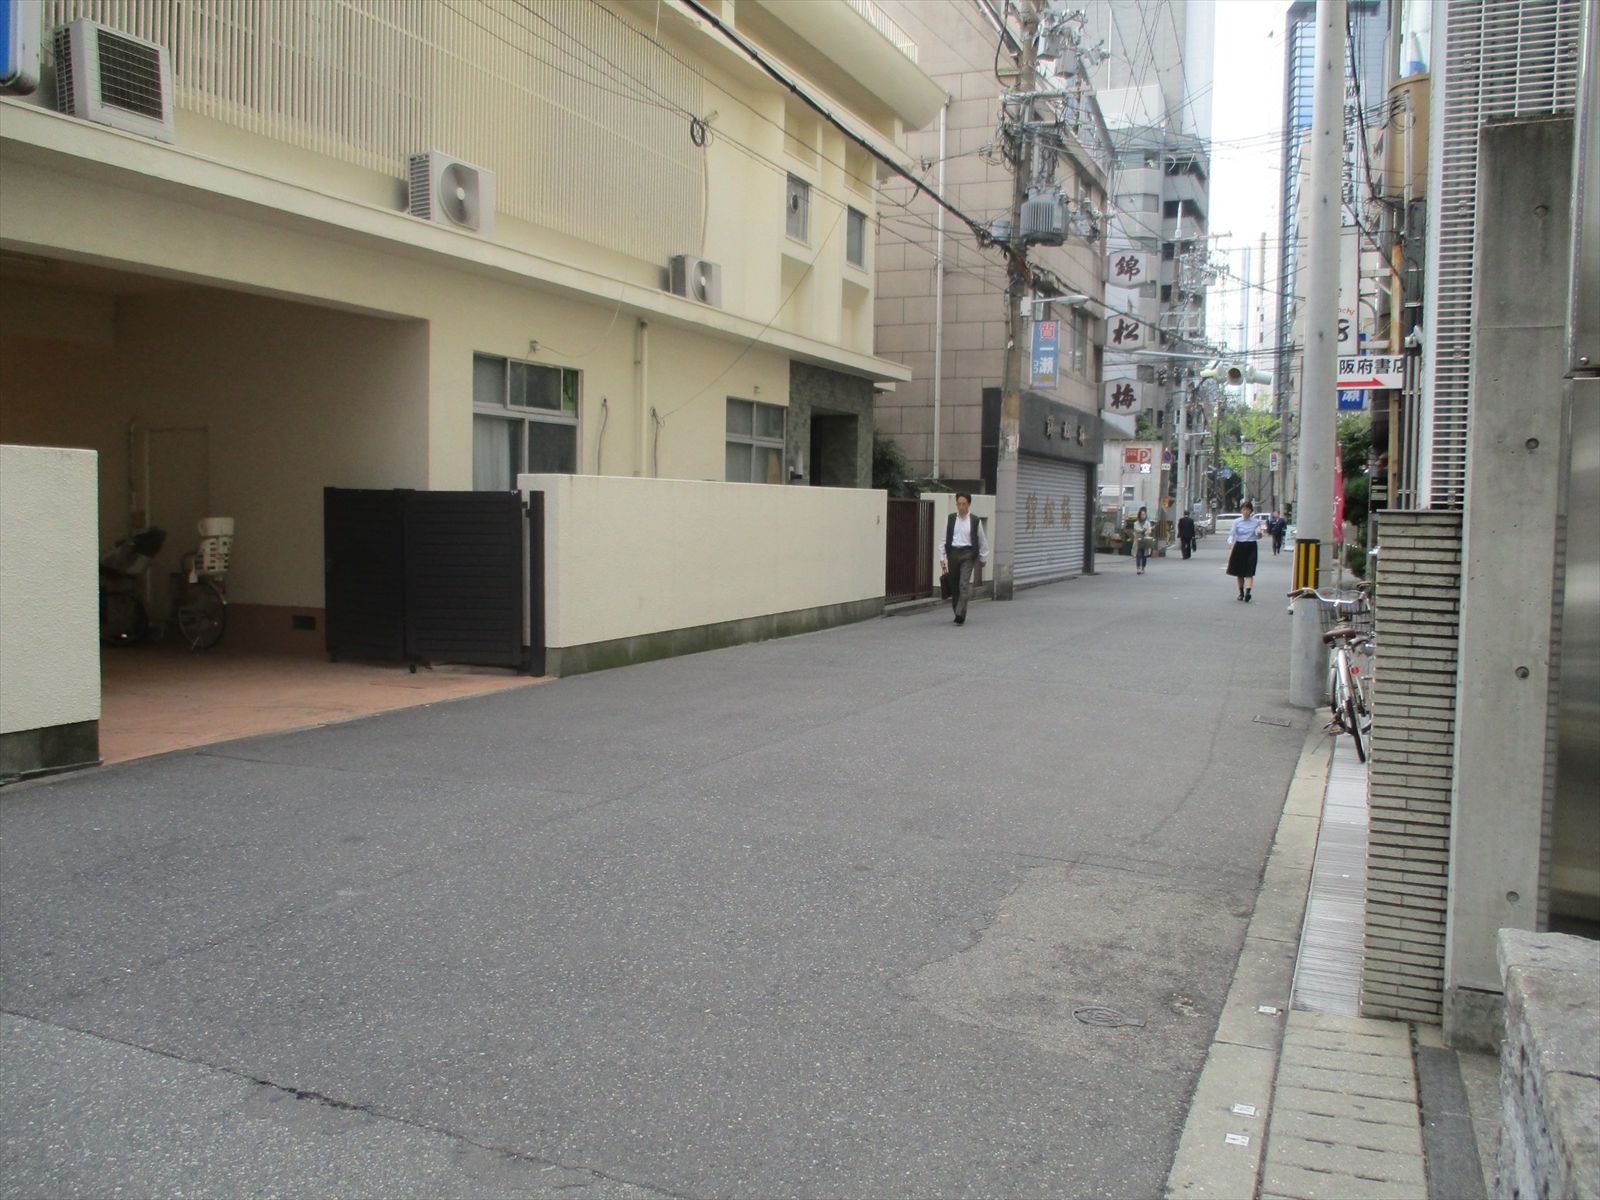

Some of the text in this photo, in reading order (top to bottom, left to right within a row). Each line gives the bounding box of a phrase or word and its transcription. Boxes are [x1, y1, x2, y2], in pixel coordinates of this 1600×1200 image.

[1115, 255, 1140, 281] 錦
[1113, 318, 1139, 345] 松
[1111, 383, 1137, 409] 梅
